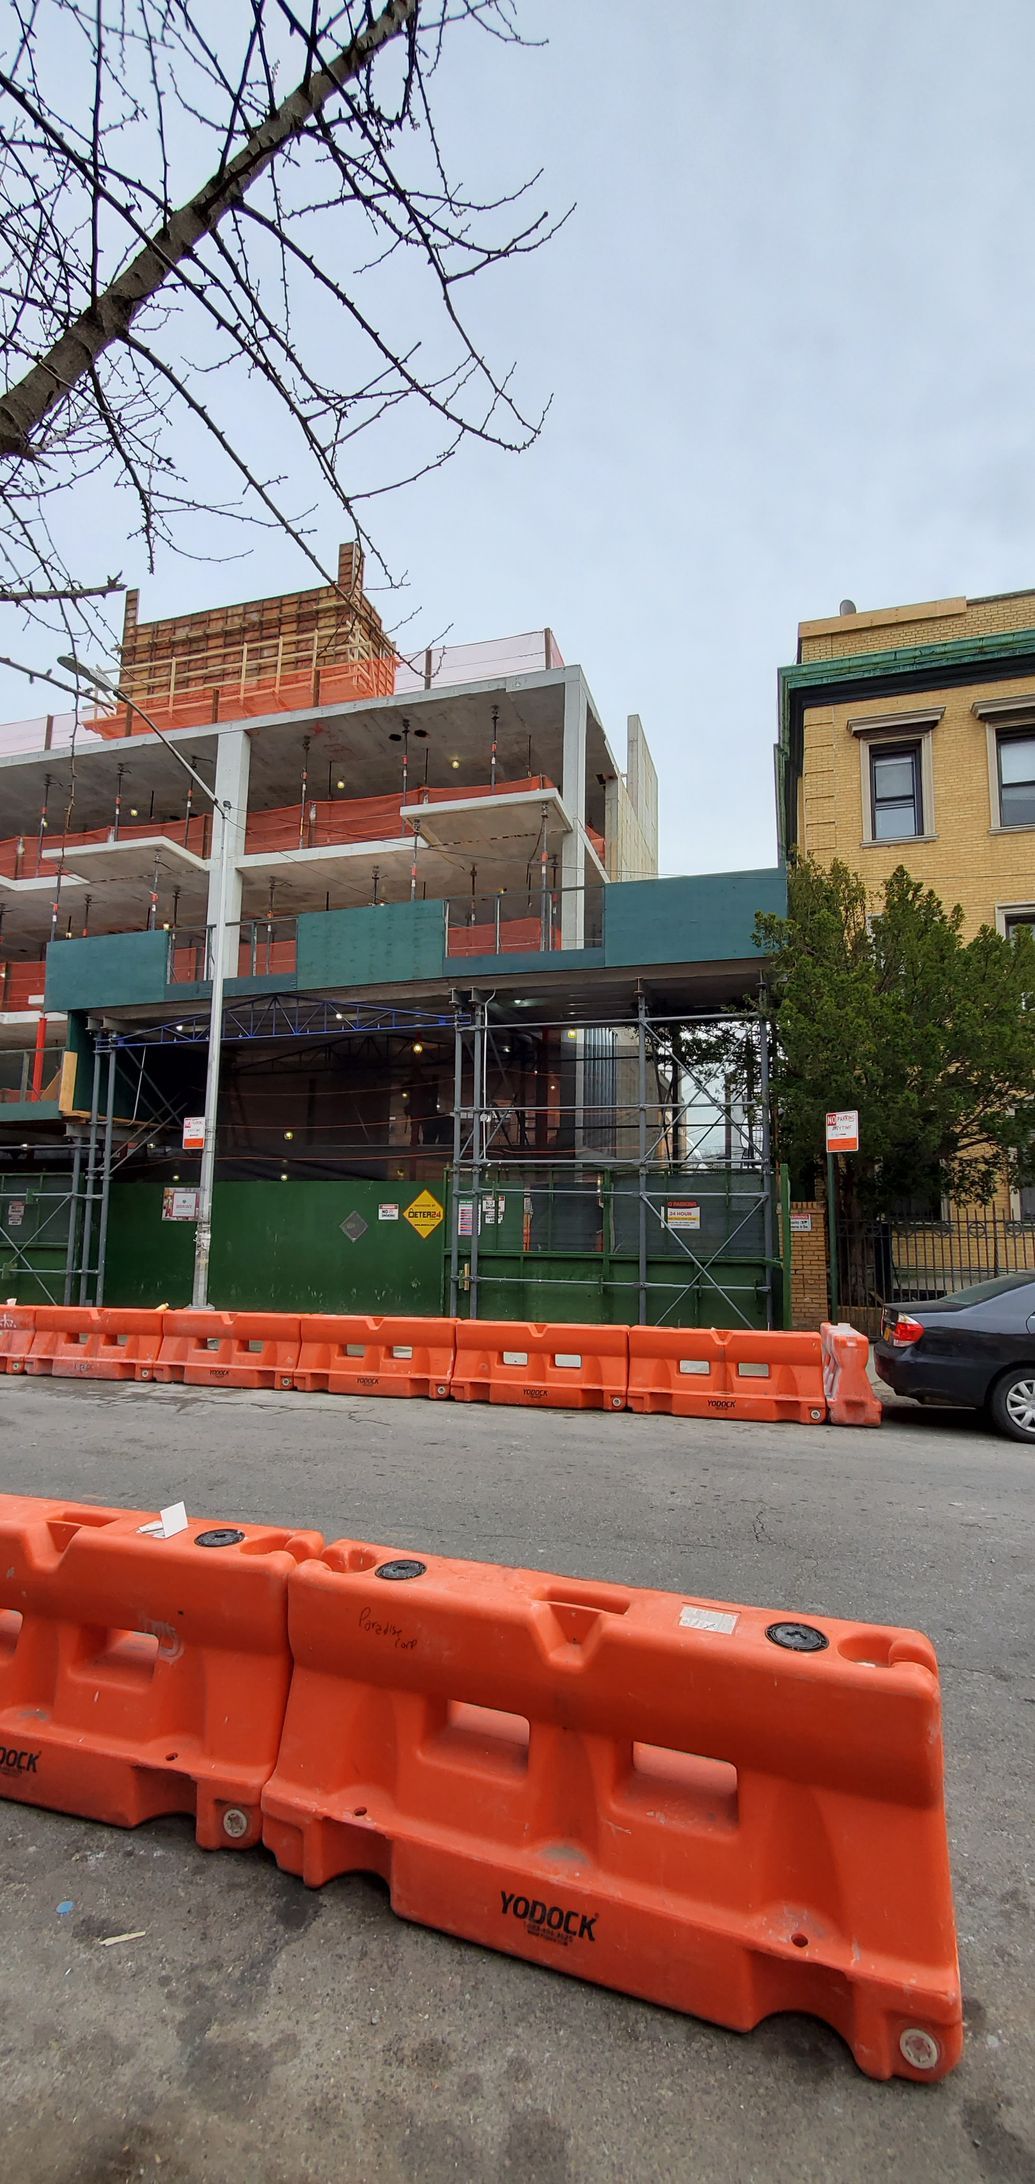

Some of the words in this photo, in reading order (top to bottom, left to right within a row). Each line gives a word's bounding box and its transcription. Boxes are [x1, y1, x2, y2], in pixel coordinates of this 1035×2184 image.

[827, 1115, 836, 1125] NO
[523, 1388, 549, 1397] YODOCK
[707, 1399, 736, 1408] YODOCK
[501, 1891, 597, 1942] YODOCK
